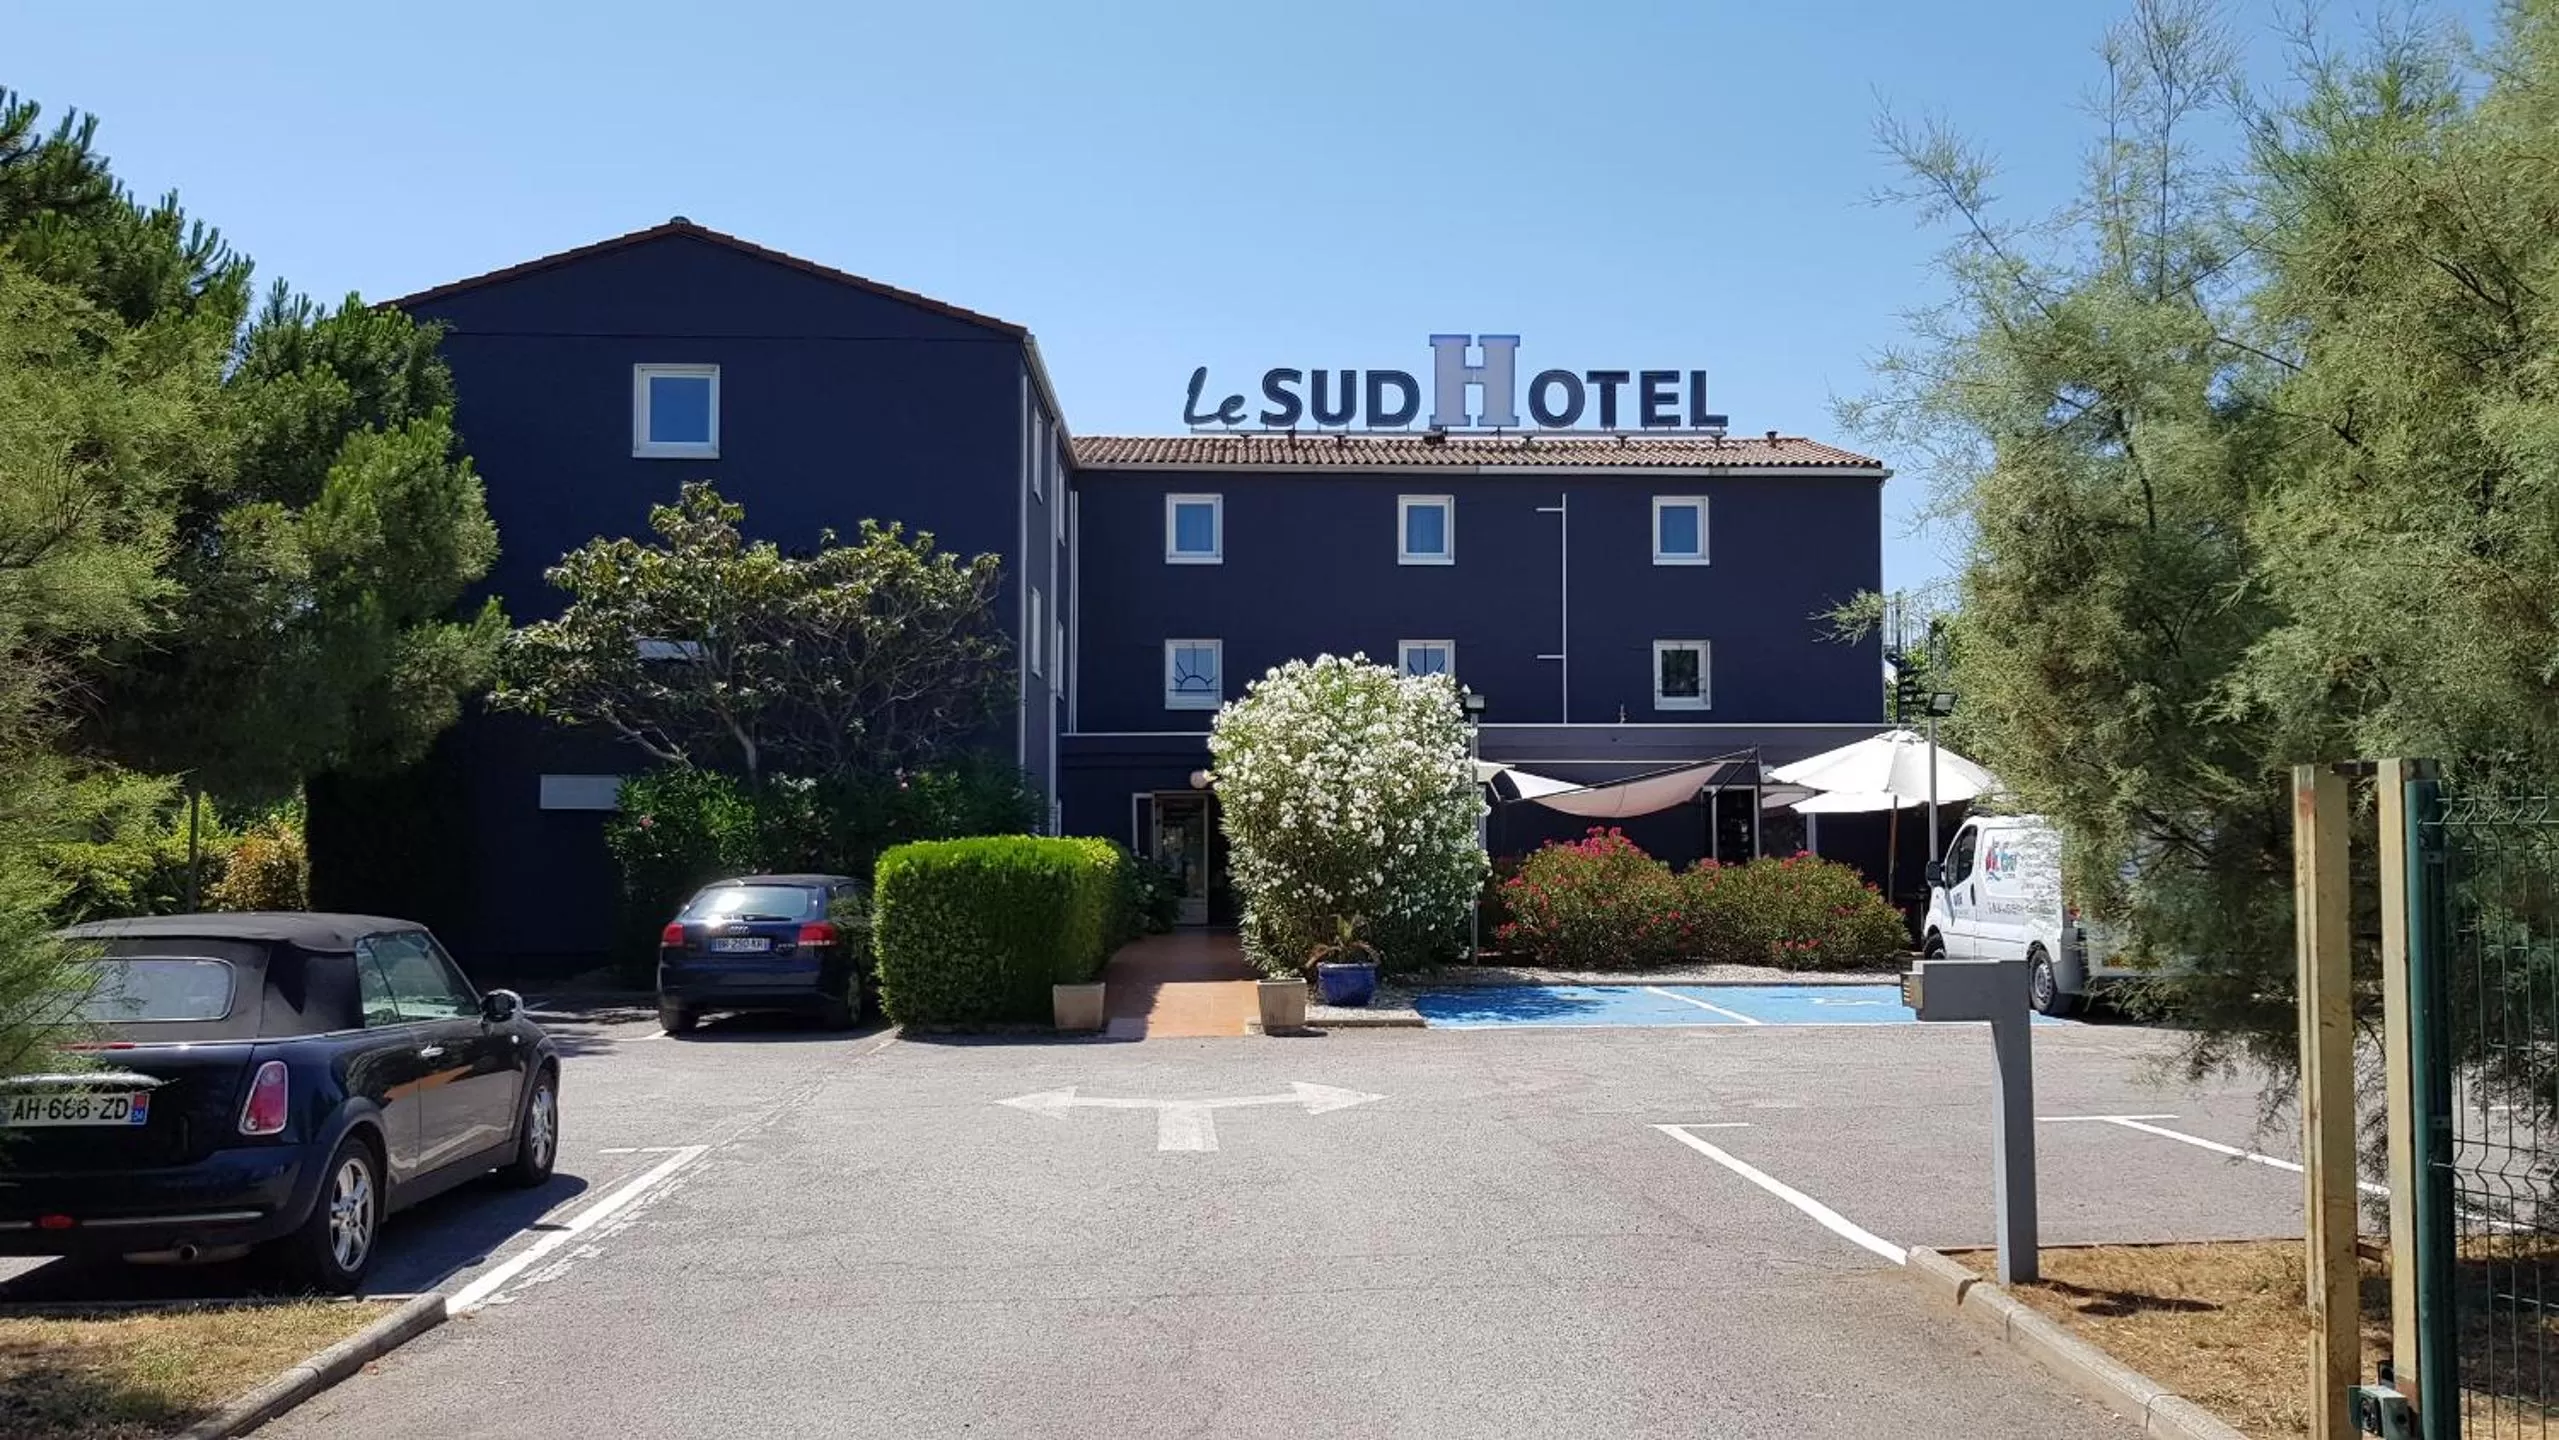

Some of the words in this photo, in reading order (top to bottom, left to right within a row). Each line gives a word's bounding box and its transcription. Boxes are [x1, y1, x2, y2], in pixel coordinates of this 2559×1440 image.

[1183, 366, 1248, 426] Le
[1260, 368, 1421, 428] SUD
[1429, 334, 1729, 428] HOTEL
